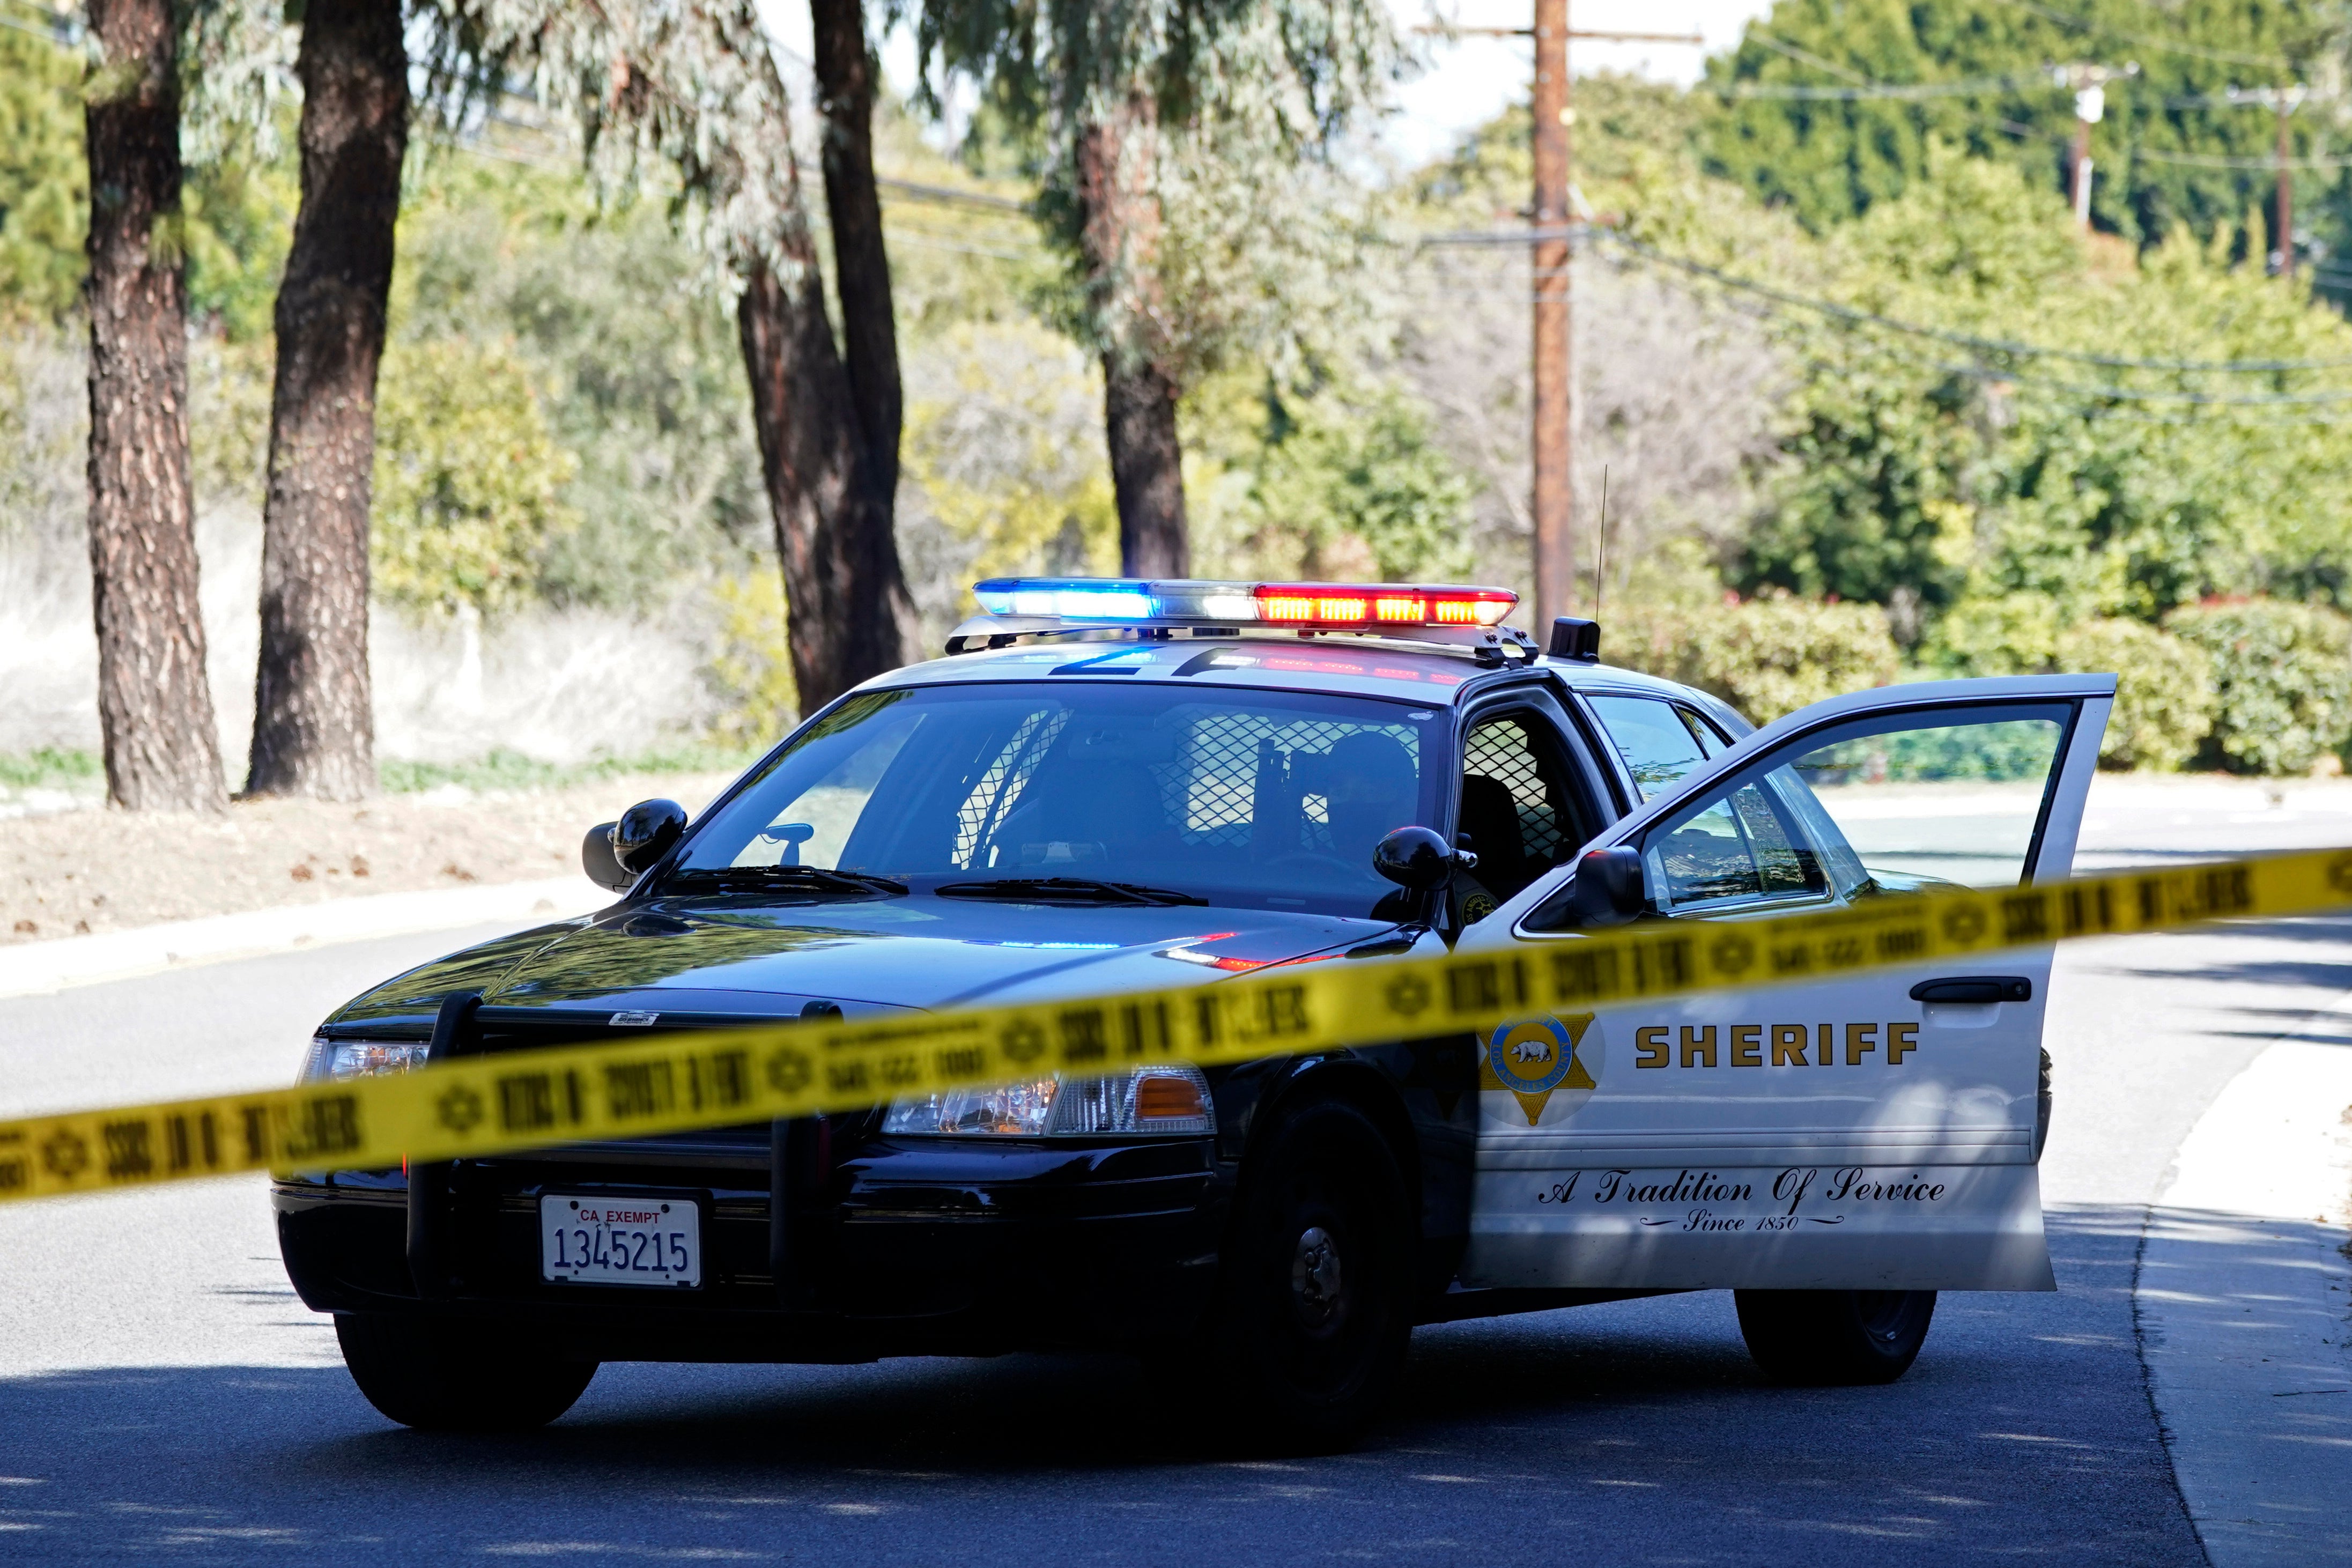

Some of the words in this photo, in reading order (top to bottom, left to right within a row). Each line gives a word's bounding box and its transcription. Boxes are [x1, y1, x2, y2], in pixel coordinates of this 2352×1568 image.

[1492, 1044, 1502, 1066] LOS
[1498, 1069, 1545, 1091] ANGELES
[1547, 1041, 1570, 1084] COUNTY
[1636, 1022, 1919, 1069] SHERIFF
[1538, 1171, 1581, 1204] A
[1594, 1170, 1753, 1203] Tradition
[1772, 1167, 1817, 1216] Of
[1826, 1167, 1945, 1201] Service
[580, 1209, 599, 1221] CA
[607, 1210, 660, 1224] EXEMPT
[1683, 1208, 1745, 1232] Since
[1755, 1216, 1799, 1231] 1850
[554, 1228, 688, 1273] 1345215
